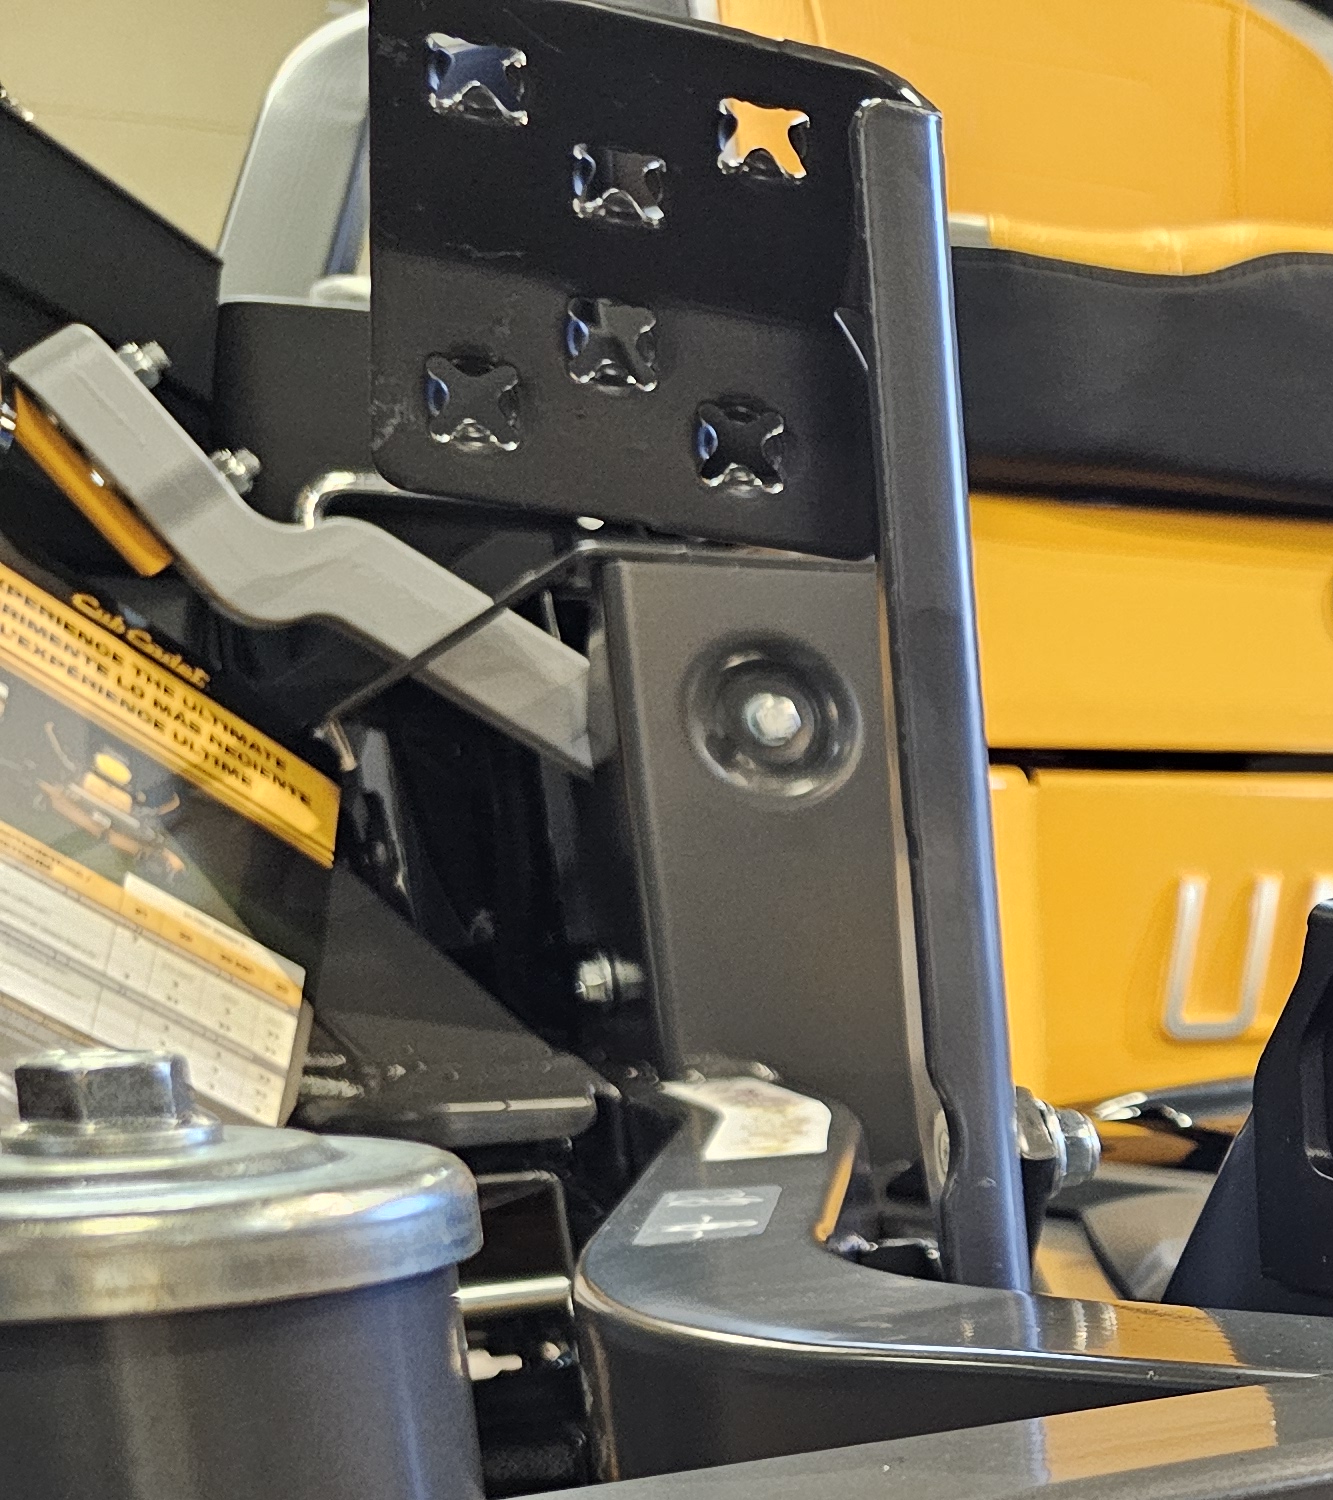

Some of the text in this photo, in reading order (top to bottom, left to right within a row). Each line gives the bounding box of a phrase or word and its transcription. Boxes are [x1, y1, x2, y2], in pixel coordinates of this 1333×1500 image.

[71, 591, 126, 635] Cub
[0, 578, 288, 772] PERIENCE THE ULTIMATE
[117, 674, 146, 701] LO
[208, 732, 312, 806] RECIENTE
[172, 731, 253, 787] ULTIME
